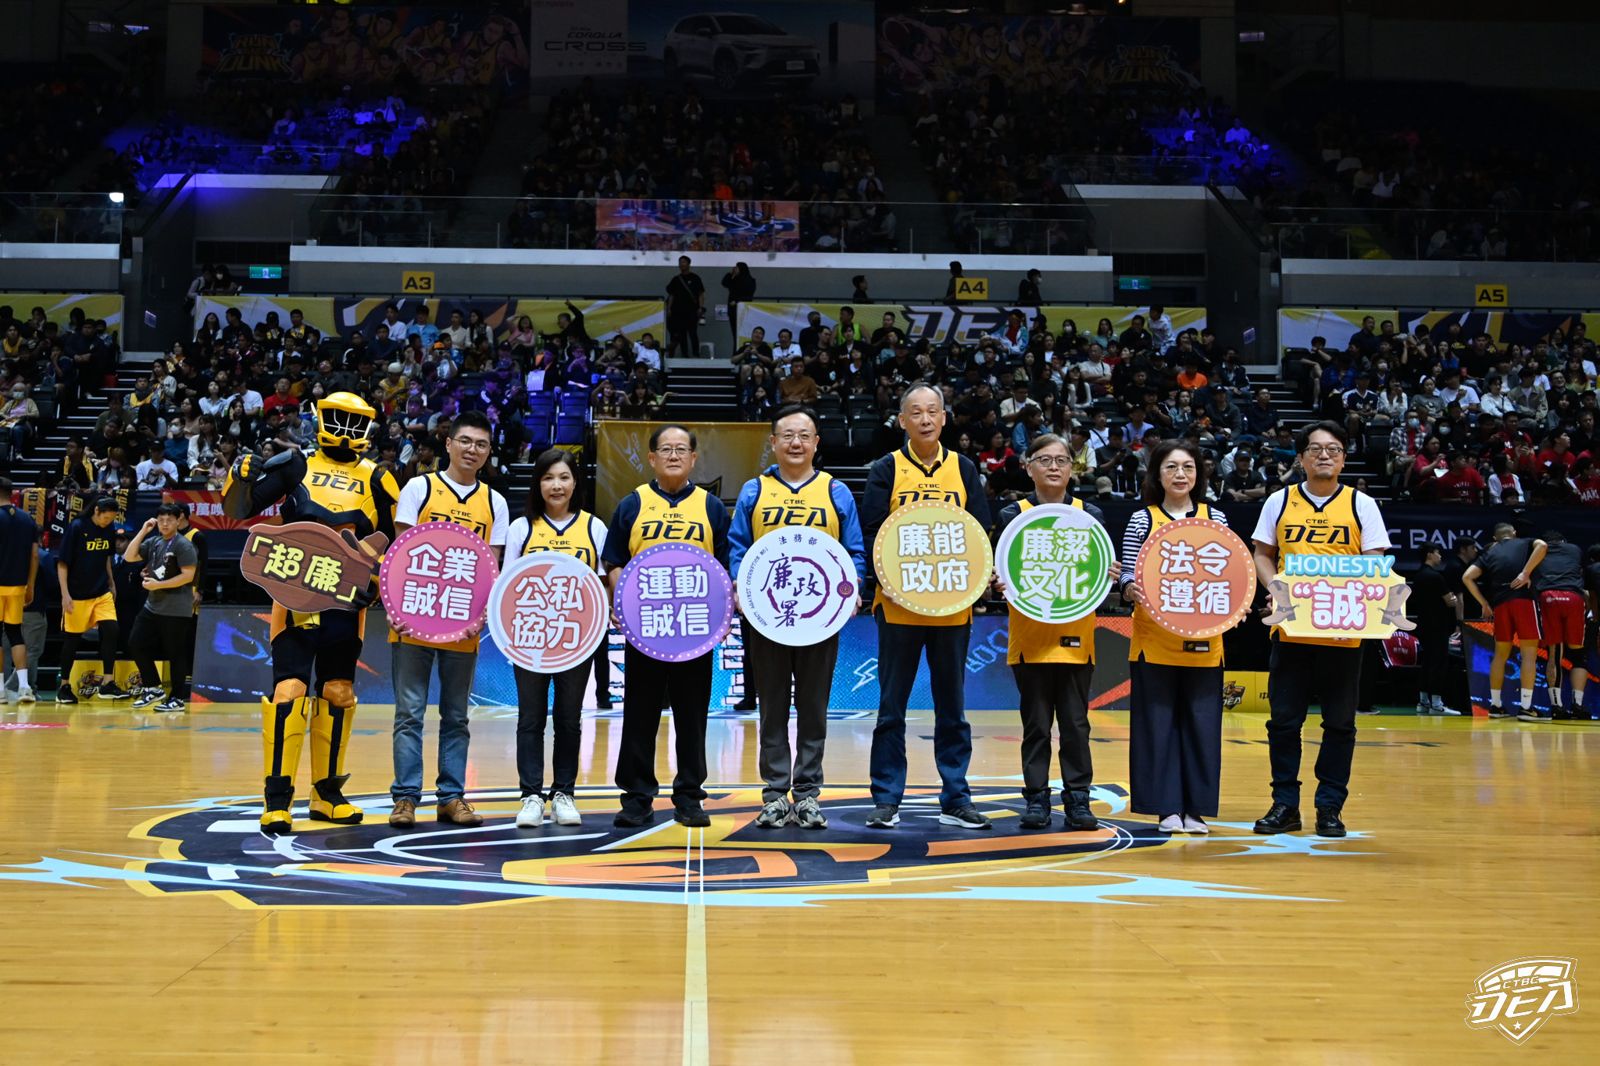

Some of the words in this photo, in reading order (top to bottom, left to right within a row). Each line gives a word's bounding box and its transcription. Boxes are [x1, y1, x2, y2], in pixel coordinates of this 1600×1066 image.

[544, 41, 648, 51] CROSS
[404, 276, 432, 290] A3
[957, 280, 986, 294] A4
[1478, 288, 1505, 302] A5
[312, 472, 364, 495] DEA
[641, 520, 704, 542] DEA
[762, 506, 827, 527] DEA
[86, 540, 110, 551] DEA
[898, 521, 967, 557] 廉能
[1020, 528, 1091, 563] 廉潔
[1284, 525, 1350, 545] DEA
[407, 543, 479, 584] 企業
[1159, 540, 1232, 576] 法令
[1286, 555, 1394, 576] HONESTY
[637, 565, 709, 600] 運動
[900, 559, 969, 593] 政府
[1019, 565, 1090, 601] 文化
[402, 581, 474, 621] 誠信
[514, 576, 585, 612] 公私
[1159, 579, 1231, 615] 遵循
[511, 613, 582, 650] 協力
[639, 603, 710, 638] 誠信
